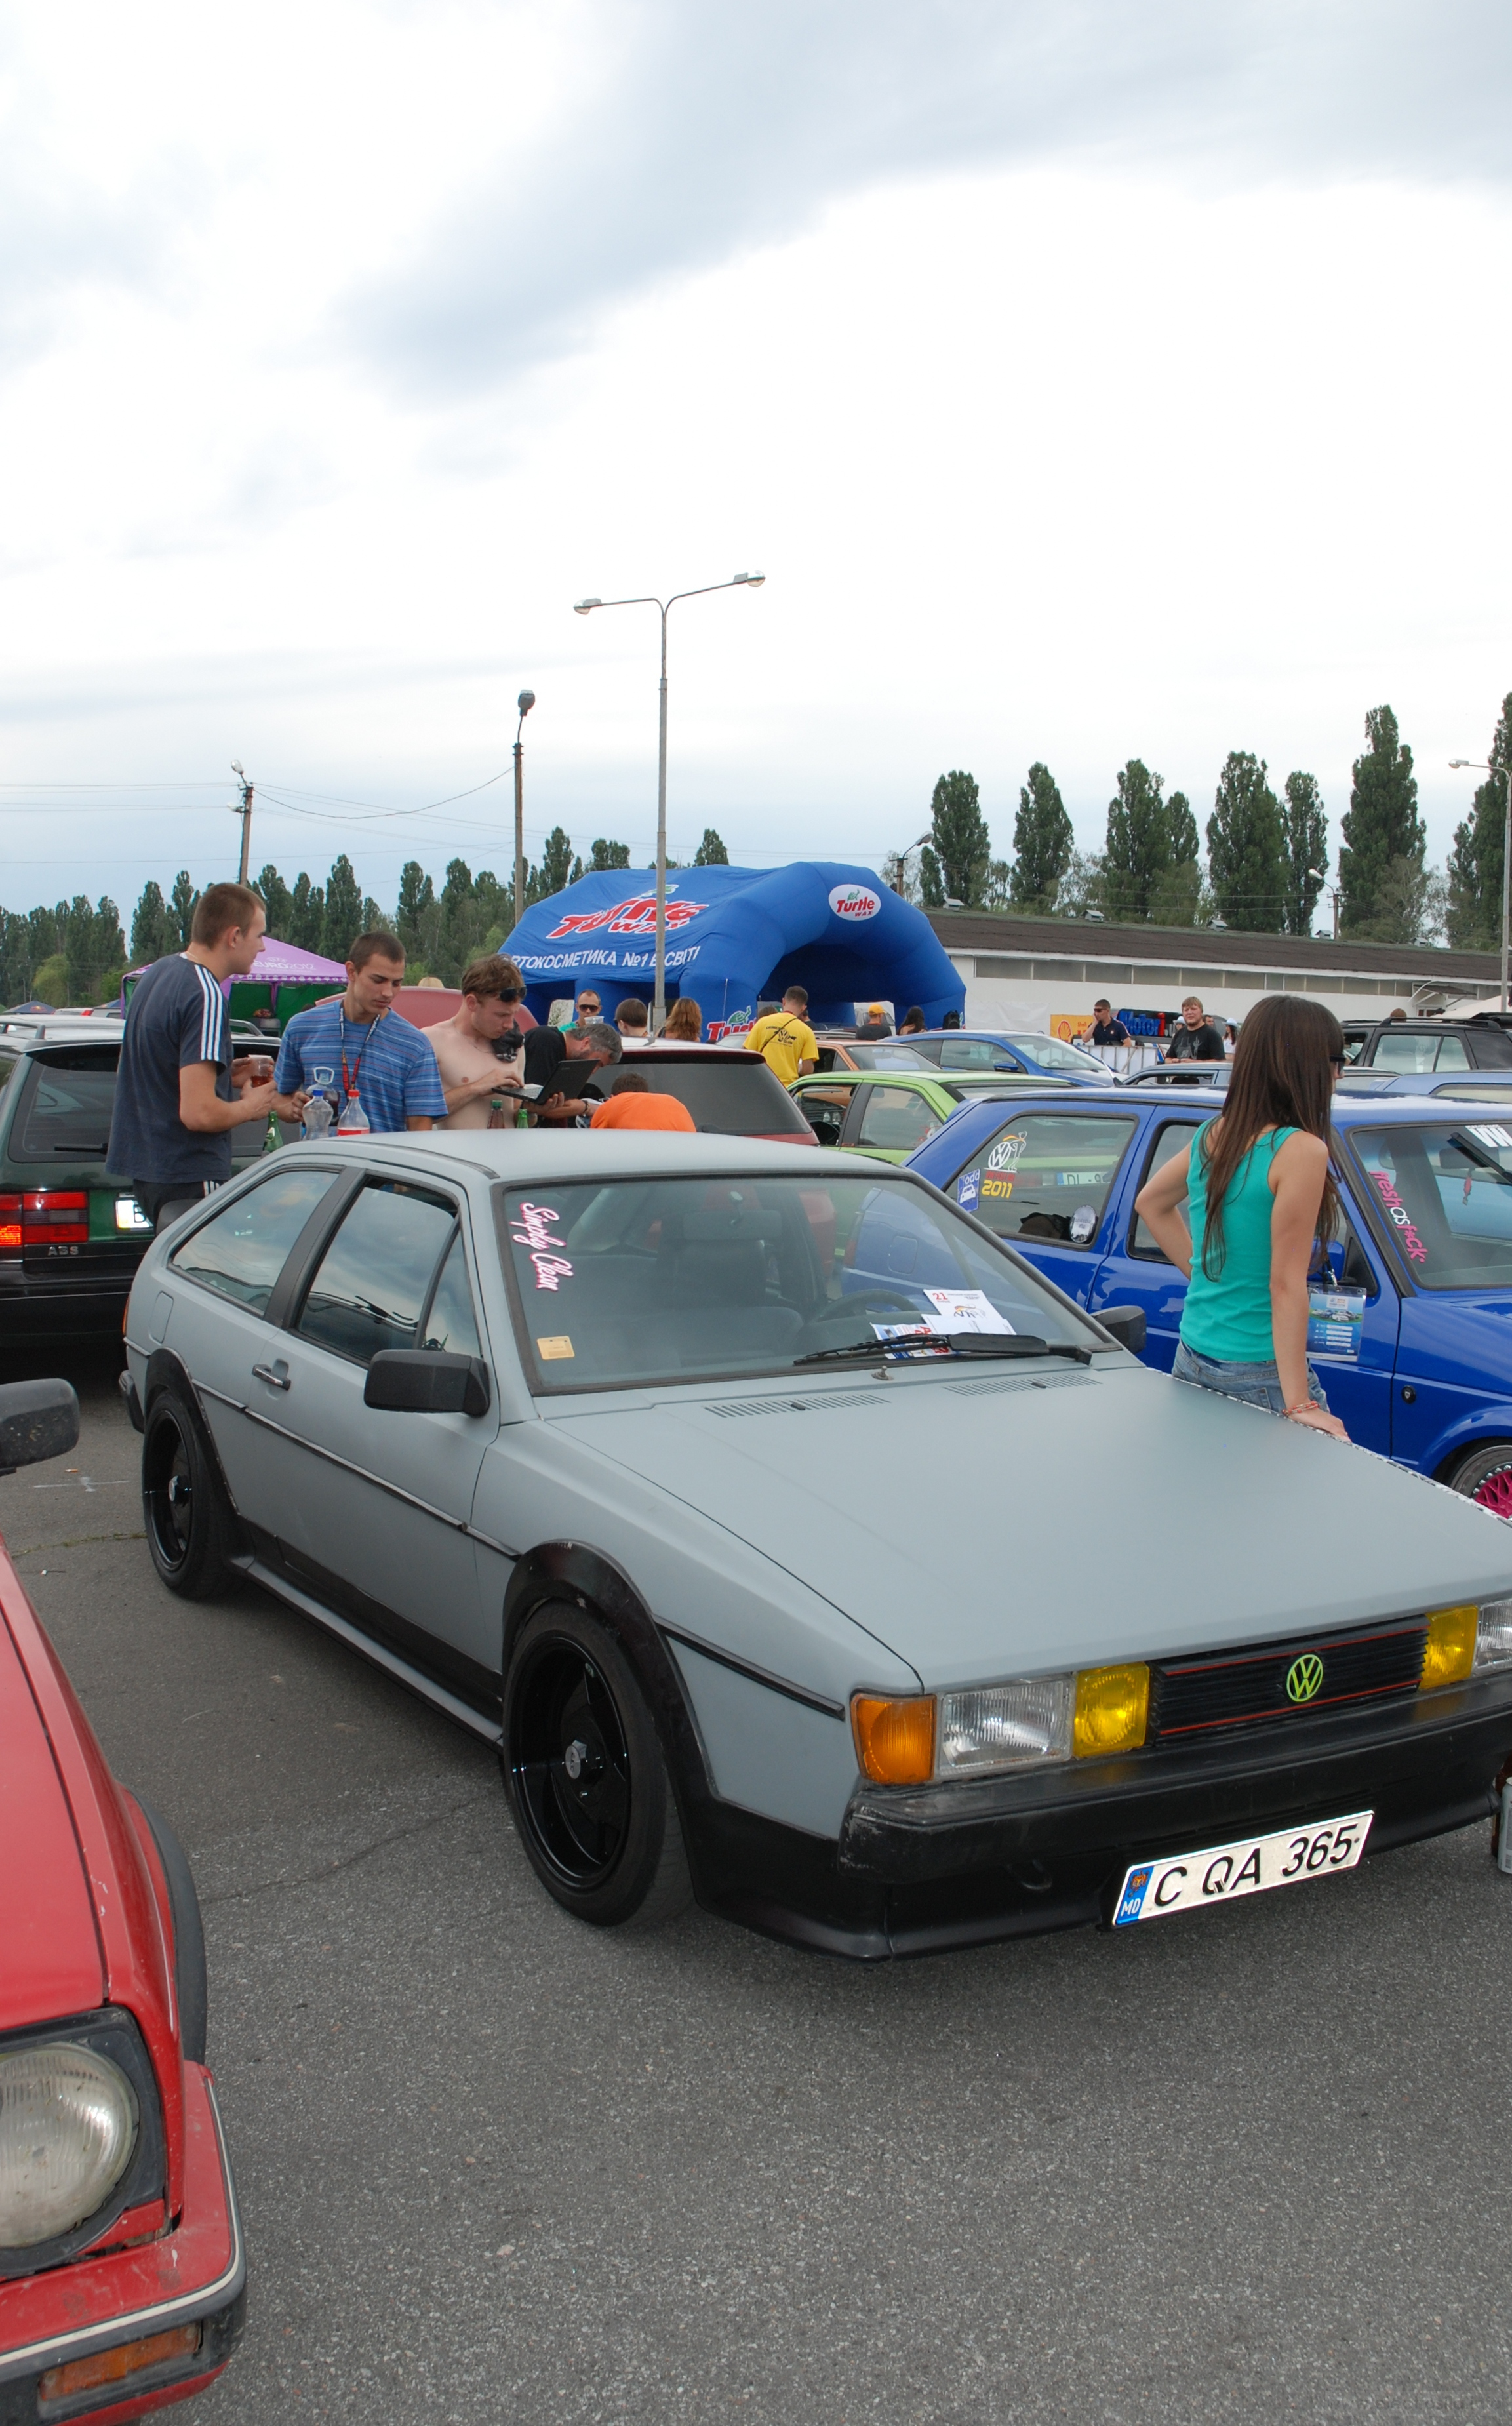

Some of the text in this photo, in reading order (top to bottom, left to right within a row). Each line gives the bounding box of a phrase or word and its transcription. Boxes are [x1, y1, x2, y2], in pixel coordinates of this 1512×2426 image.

[837, 896, 875, 913] Turtle
[511, 949, 616, 969] ВТОКОСМЕТИКА
[982, 1180, 1013, 1199] 2011
[48, 1246, 79, 1256] ABS
[509, 1202, 574, 1291] Simply Clean
[1154, 1823, 1359, 1907] C QA 365
[1120, 1898, 1141, 1917] MD
